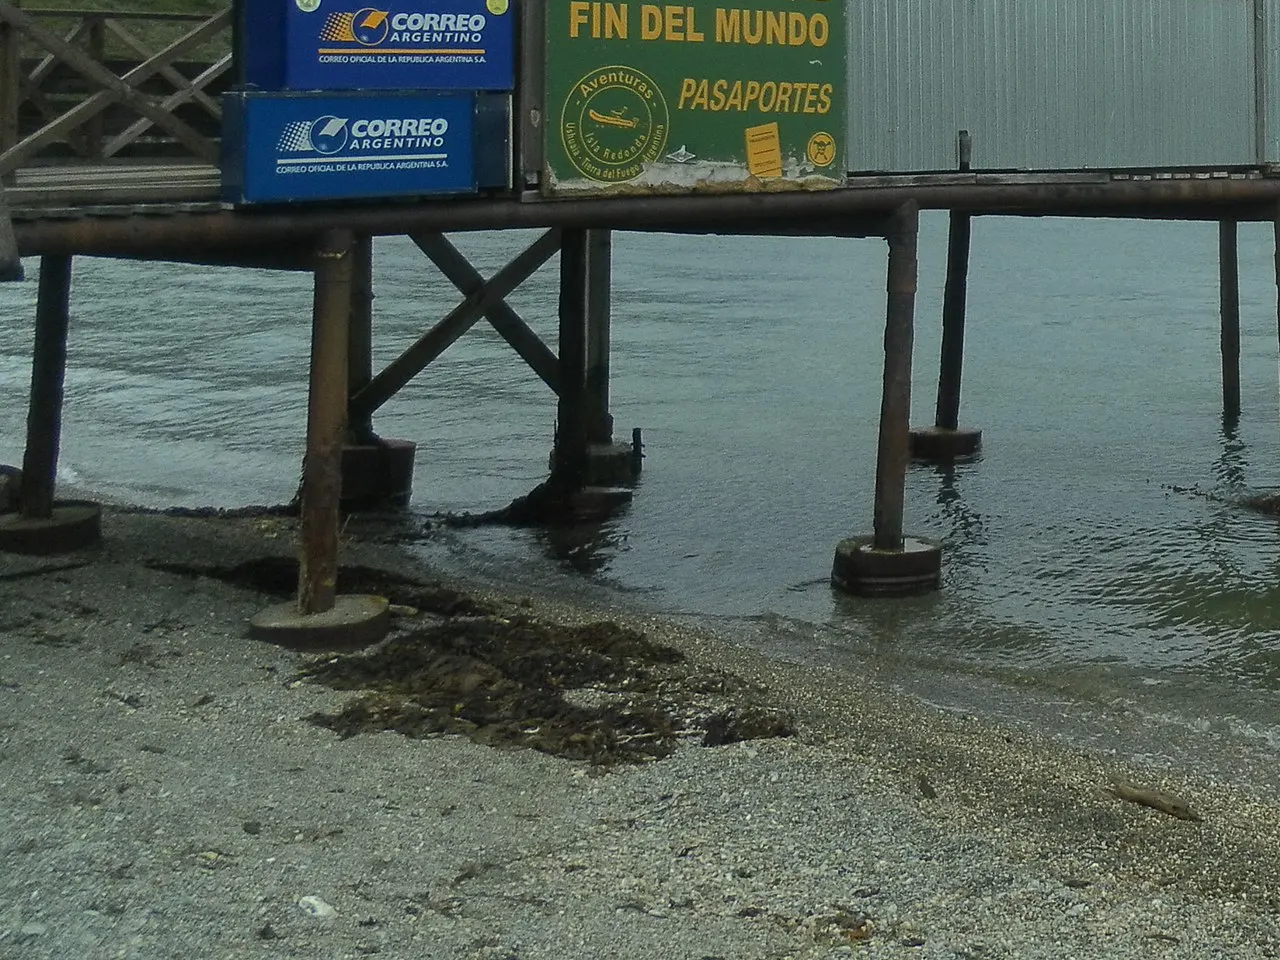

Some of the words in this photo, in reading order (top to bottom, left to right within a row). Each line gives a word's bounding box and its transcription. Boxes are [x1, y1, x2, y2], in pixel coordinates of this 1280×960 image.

[391, 12, 486, 32] CORREO
[569, 1, 628, 40] FIN
[641, 4, 705, 42] DEL
[715, 8, 830, 48] MUNDO
[390, 32, 482, 43] ARGENTINO
[318, 55, 349, 63] CORREO
[349, 55, 377, 63] OFICIAL
[377, 55, 387, 63] DE
[387, 55, 398, 63] LA
[434, 55, 474, 63] ARGENTINA
[474, 55, 486, 63] S.A.
[580, 71, 654, 99] Aventuras
[678, 78, 833, 115] PASAPORTES
[351, 118, 448, 138] CORREO
[349, 137, 444, 150] ARGENTINO
[566, 122, 581, 157] Ushuaia
[602, 169, 615, 179] del
[616, 164, 640, 178] Fuego
[585, 132, 600, 153] Isla
[603, 134, 646, 160] Redonda
[276, 165, 307, 174] CORREO
[307, 164, 335, 173] OFICIAL
[336, 163, 346, 172] DE
[347, 163, 357, 171] LA
[395, 161, 435, 170] ARGENTINA
[436, 160, 449, 168] S.A.
